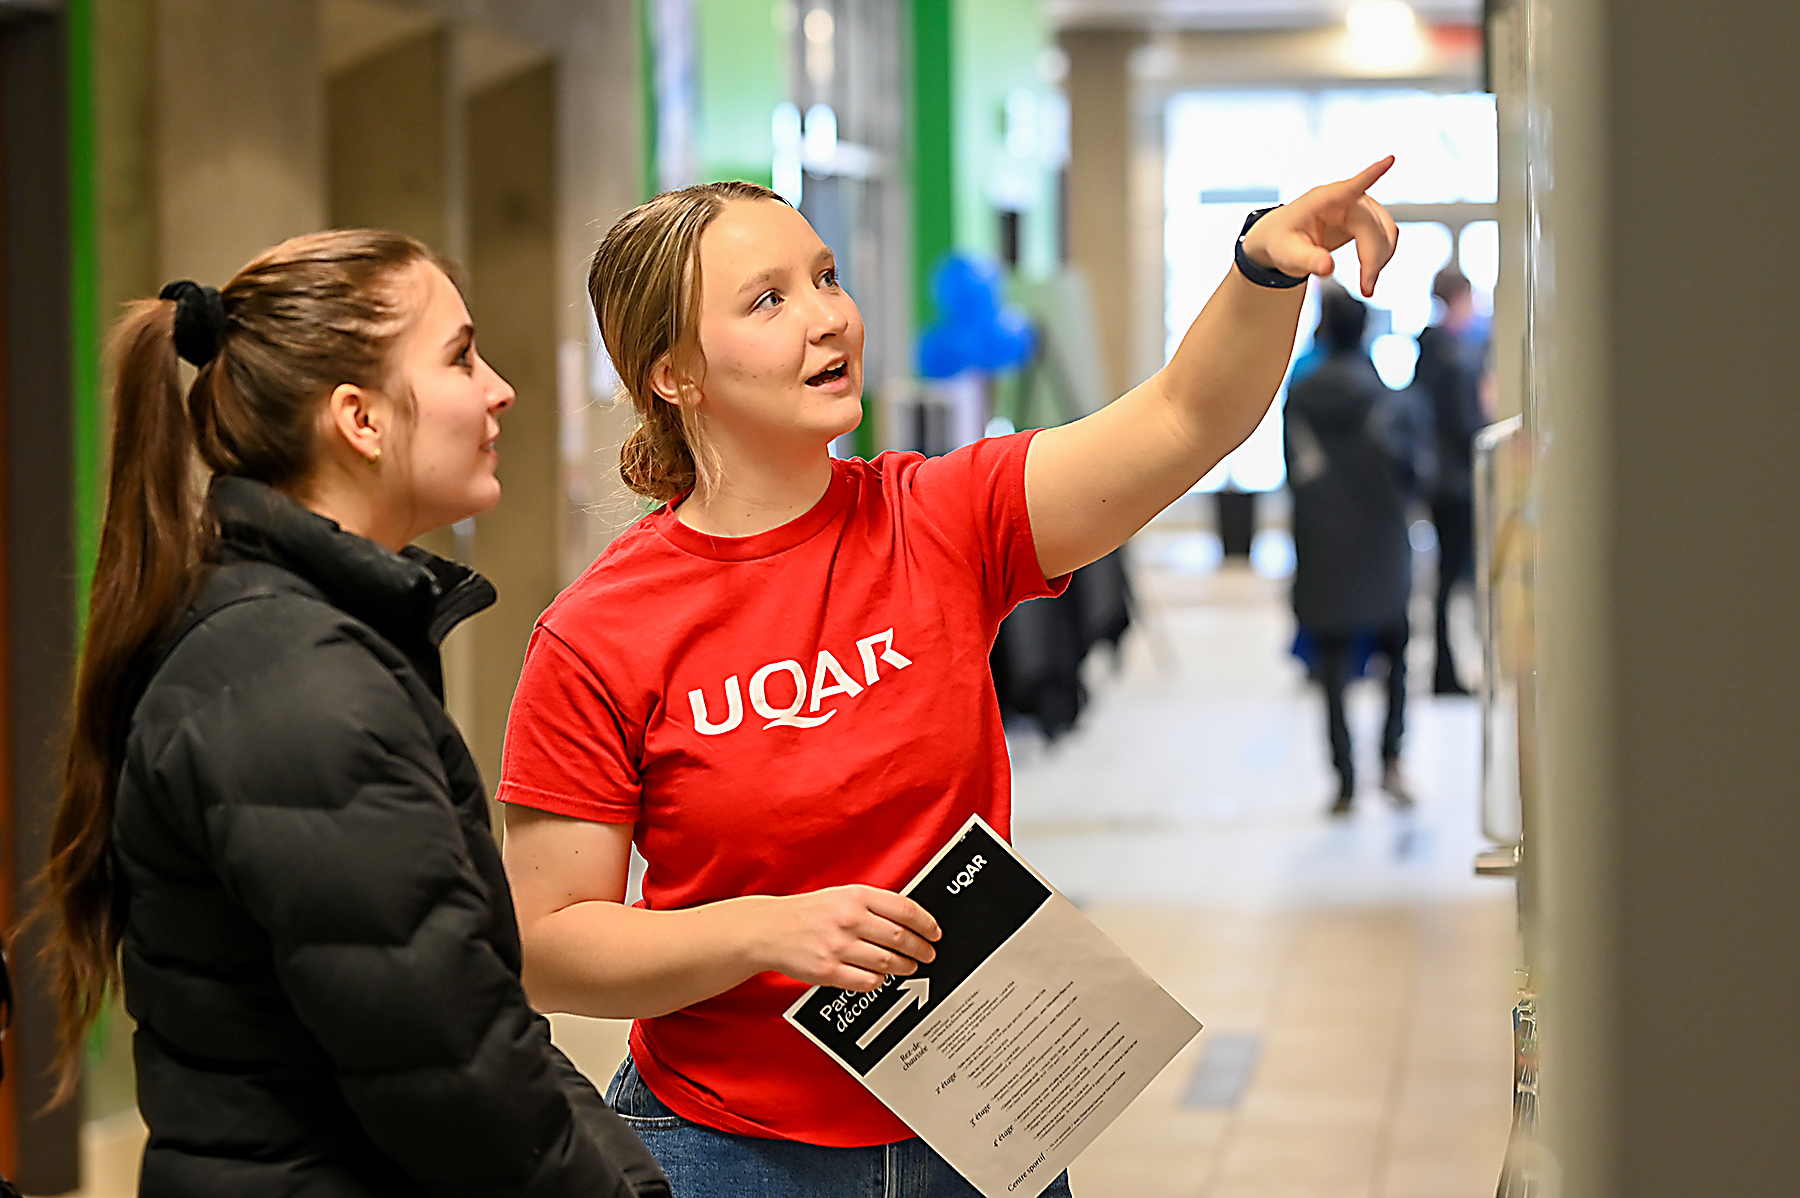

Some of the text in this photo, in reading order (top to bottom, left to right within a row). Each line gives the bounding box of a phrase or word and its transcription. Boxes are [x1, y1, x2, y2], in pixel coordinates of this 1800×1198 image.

[688, 627, 913, 735] UQAR
[946, 855, 987, 894] UQAR
[903, 1045, 928, 1071] chaussée
[940, 1072, 957, 1089] étage
[974, 1103, 992, 1121] étage
[997, 1124, 1015, 1142] étage
[1007, 1152, 1046, 1192] Centre sportif
